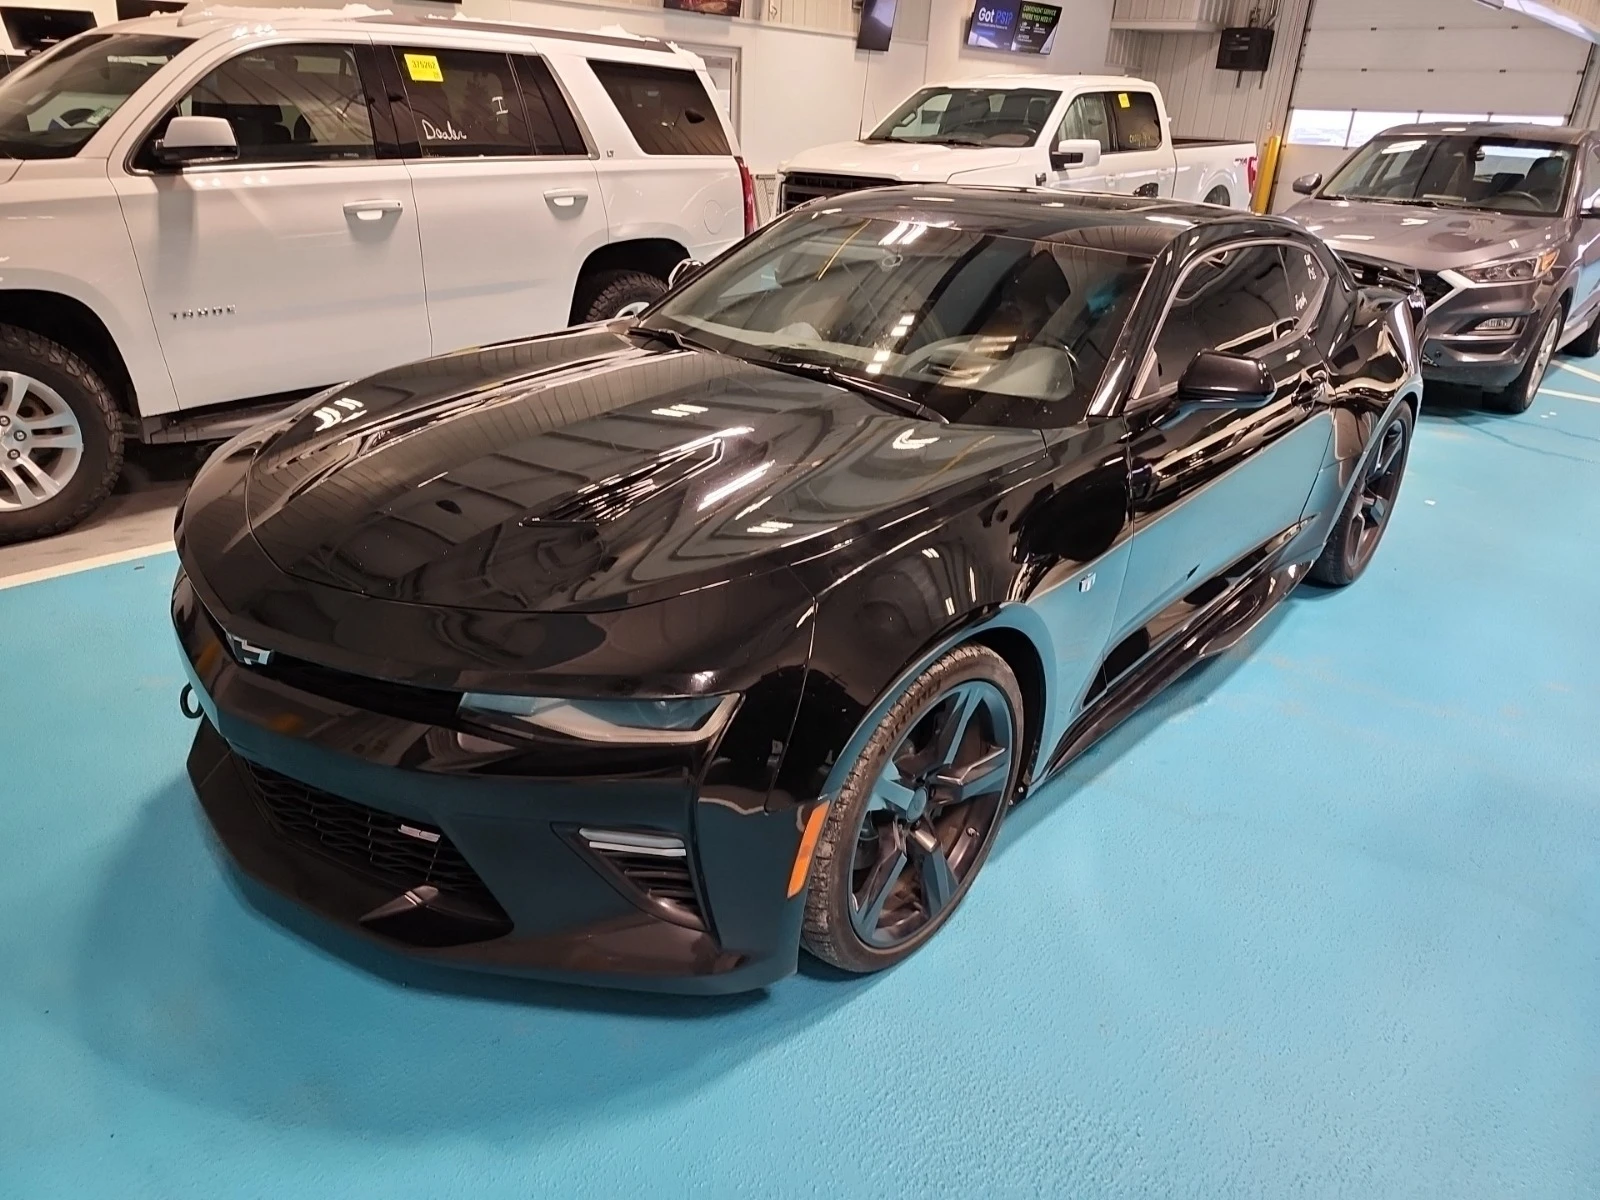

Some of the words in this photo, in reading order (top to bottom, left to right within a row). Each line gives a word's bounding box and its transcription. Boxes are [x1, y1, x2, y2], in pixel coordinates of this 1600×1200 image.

[978, 7, 995, 23] Got
[995, 9, 1014, 25] PSI?
[421, 118, 467, 141] Dealer
